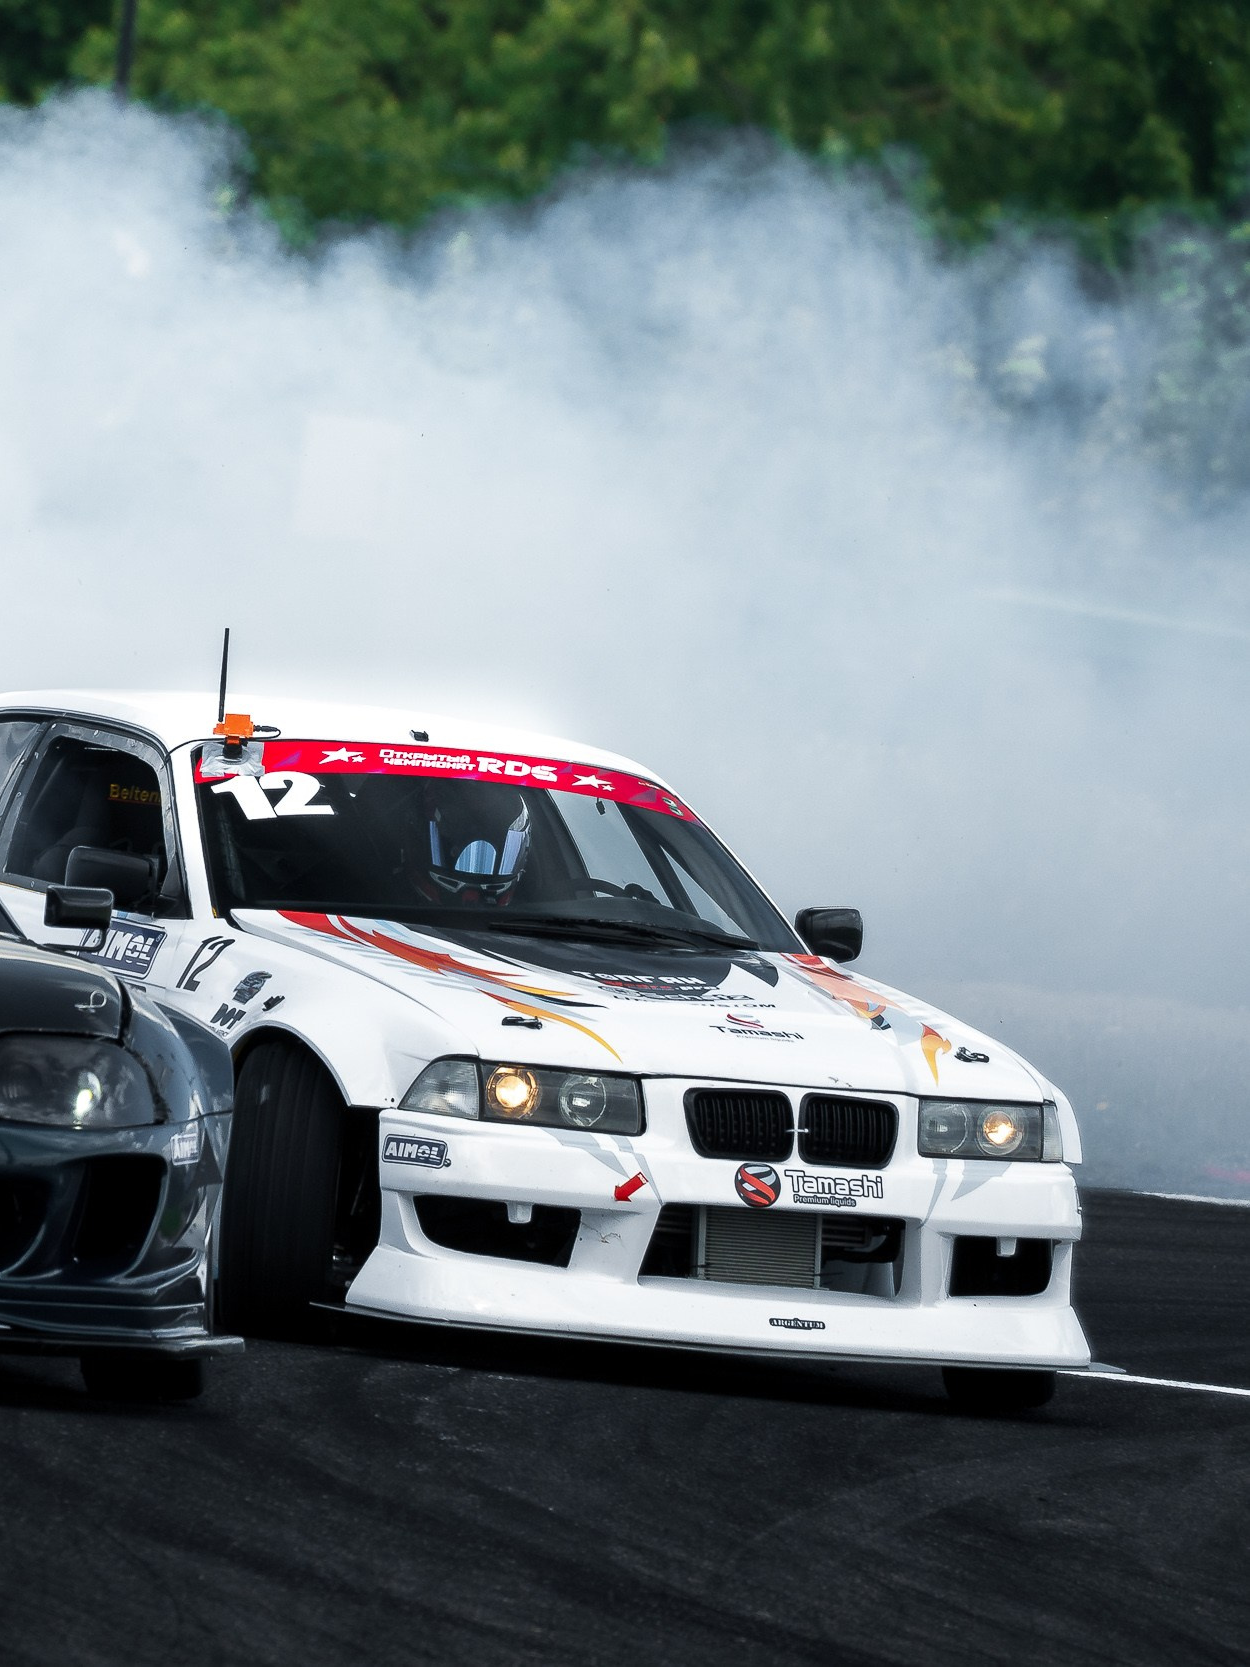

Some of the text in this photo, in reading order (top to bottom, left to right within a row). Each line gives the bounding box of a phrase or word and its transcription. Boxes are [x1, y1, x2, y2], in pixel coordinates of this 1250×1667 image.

[476, 757, 558, 783] RDS
[110, 783, 162, 803] Belten
[211, 771, 335, 821] 12
[176, 935, 235, 992] 12
[709, 1025, 804, 1040] Tamashi
[385, 1141, 442, 1163] AIMOL
[784, 1169, 884, 1199] Tamashi
[793, 1194, 857, 1208] Premium liquids
[770, 1319, 824, 1329] ARGENTUM
